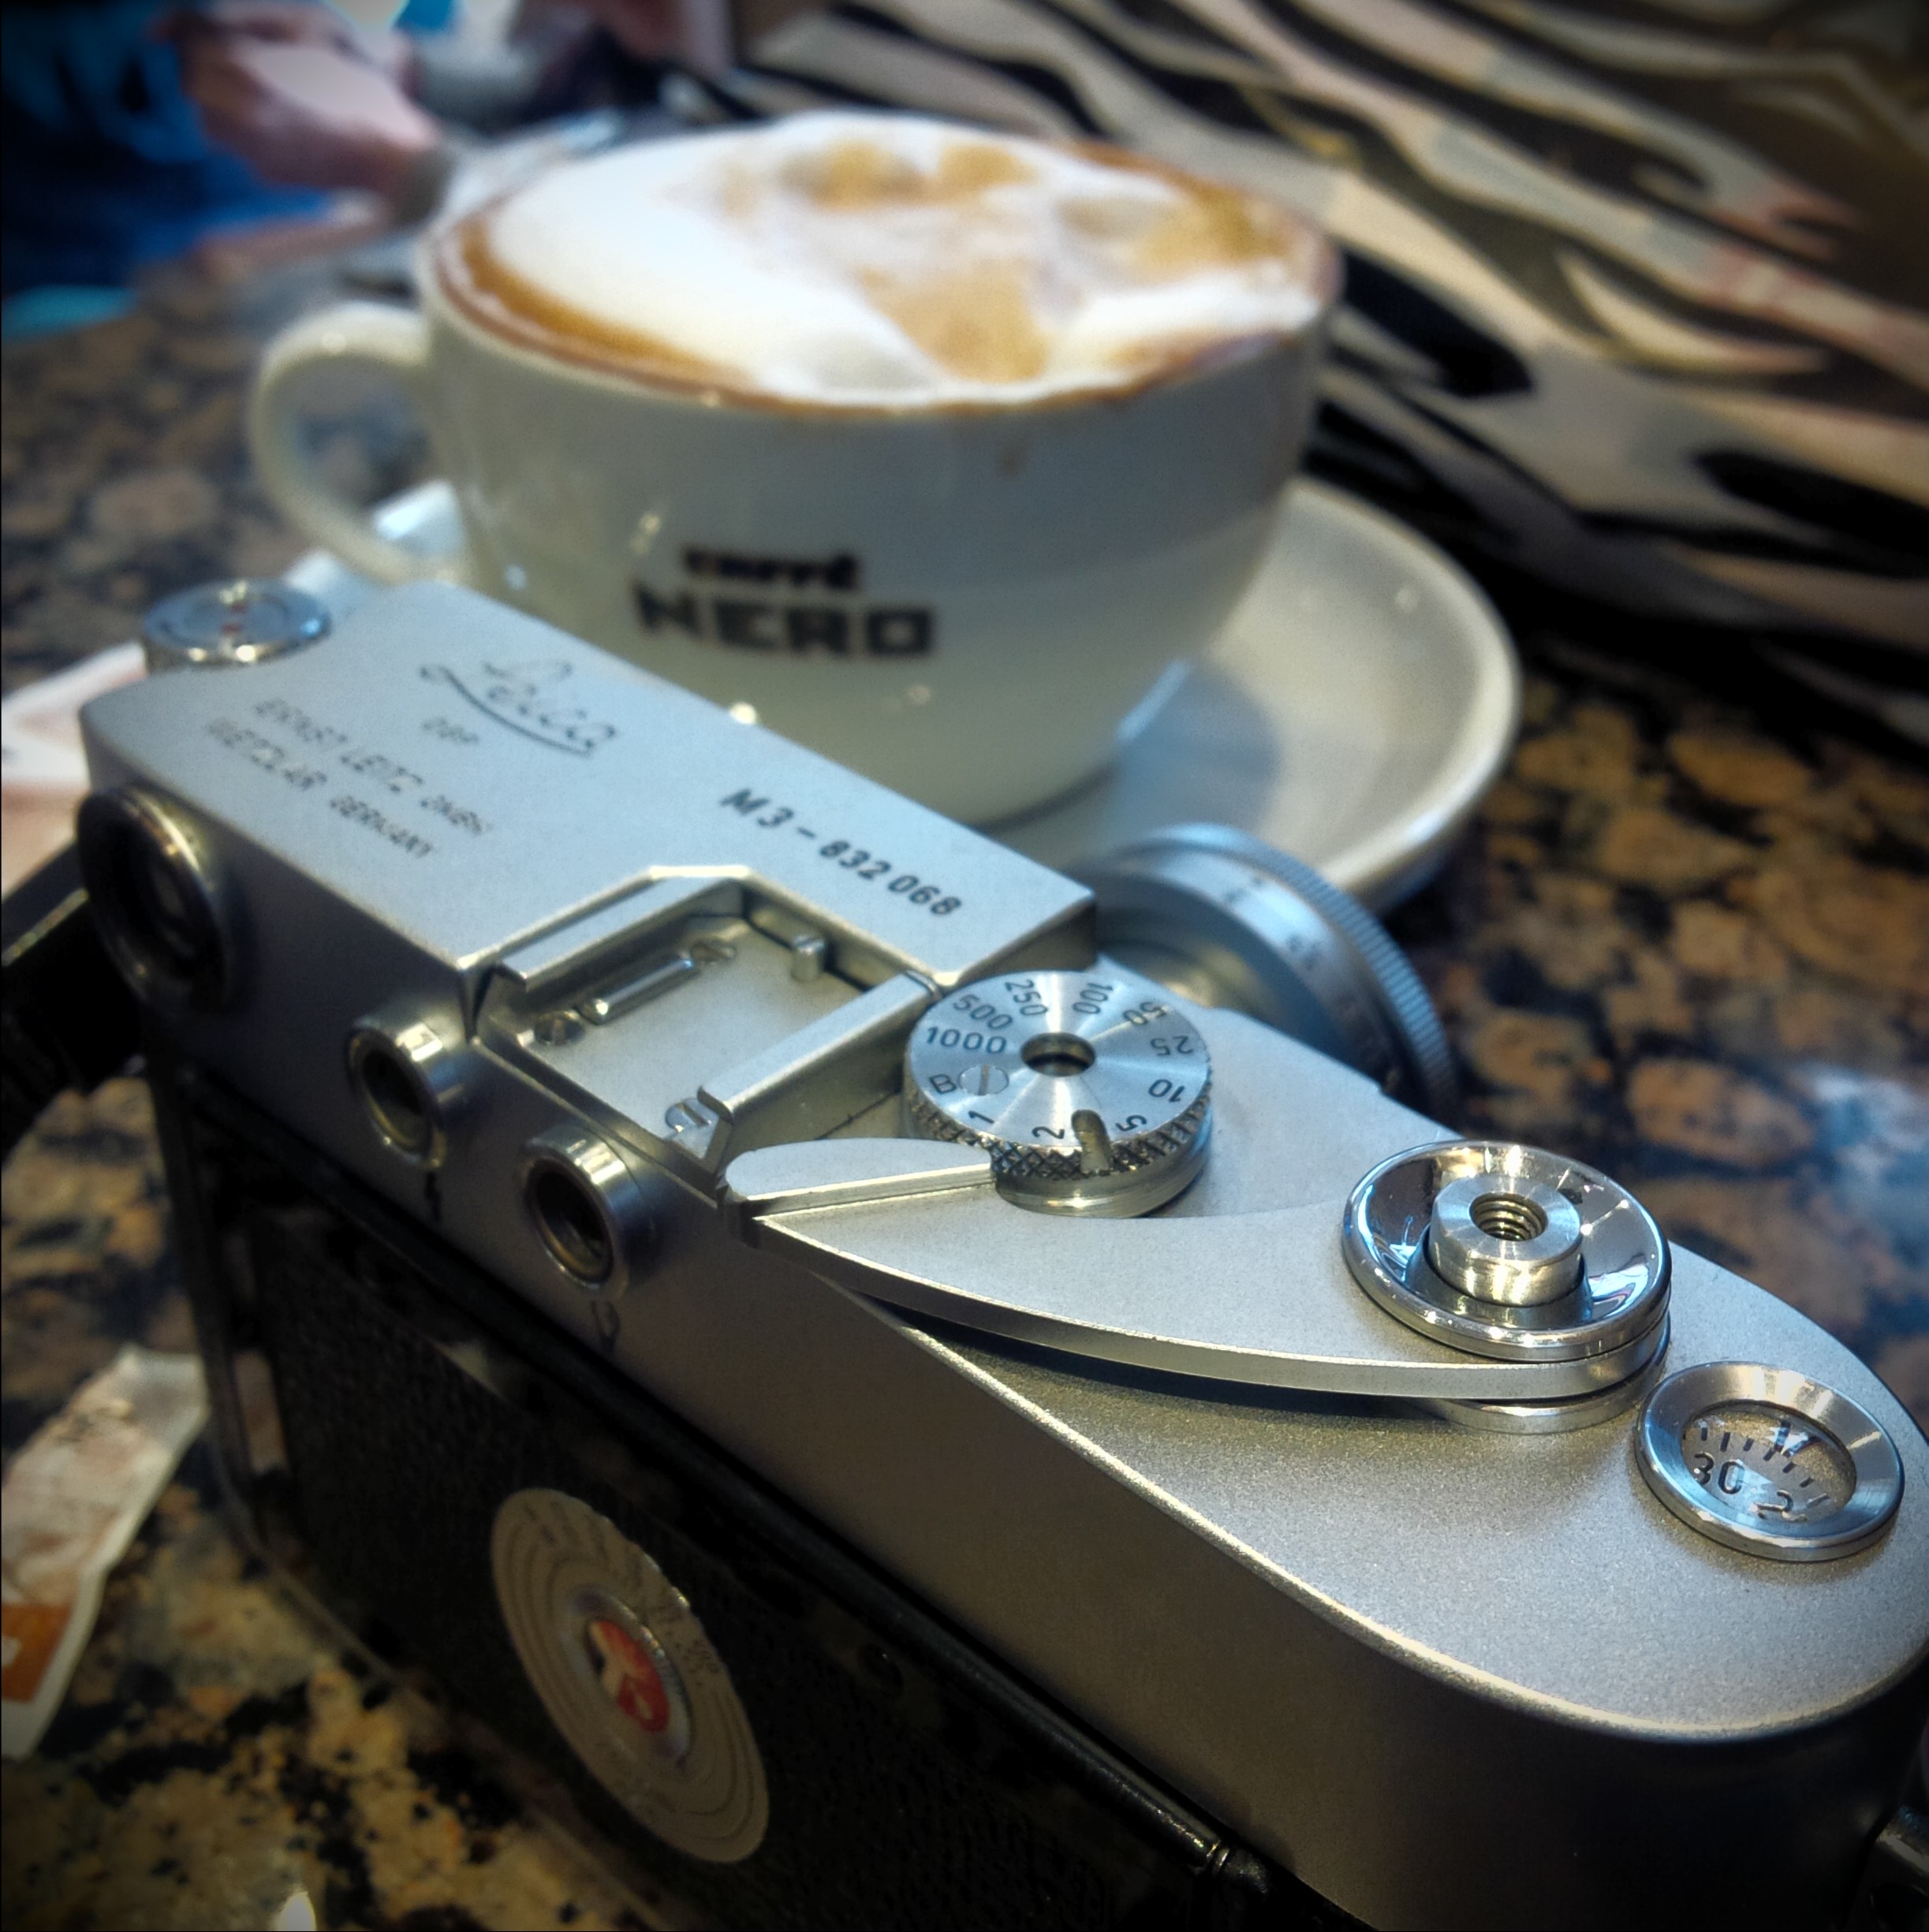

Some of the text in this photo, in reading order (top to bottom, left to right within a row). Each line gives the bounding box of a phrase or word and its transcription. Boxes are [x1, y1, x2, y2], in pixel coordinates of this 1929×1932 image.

[631, 577, 934, 658] NERO
[1005, 979, 1048, 1016] 250
[1073, 982, 1114, 1015] 100
[953, 994, 1013, 1031] 500
[1122, 1001, 1169, 1026] 50
[926, 1026, 1007, 1054] 1000
[1150, 1035, 1194, 1056] 25
[928, 1073, 958, 1095] B
[1148, 1079, 1186, 1103] 10
[968, 1110, 995, 1125] 1
[1115, 1113, 1147, 1132] 5
[1032, 1125, 1065, 1140] 2
[1692, 1451, 1745, 1494] 30
